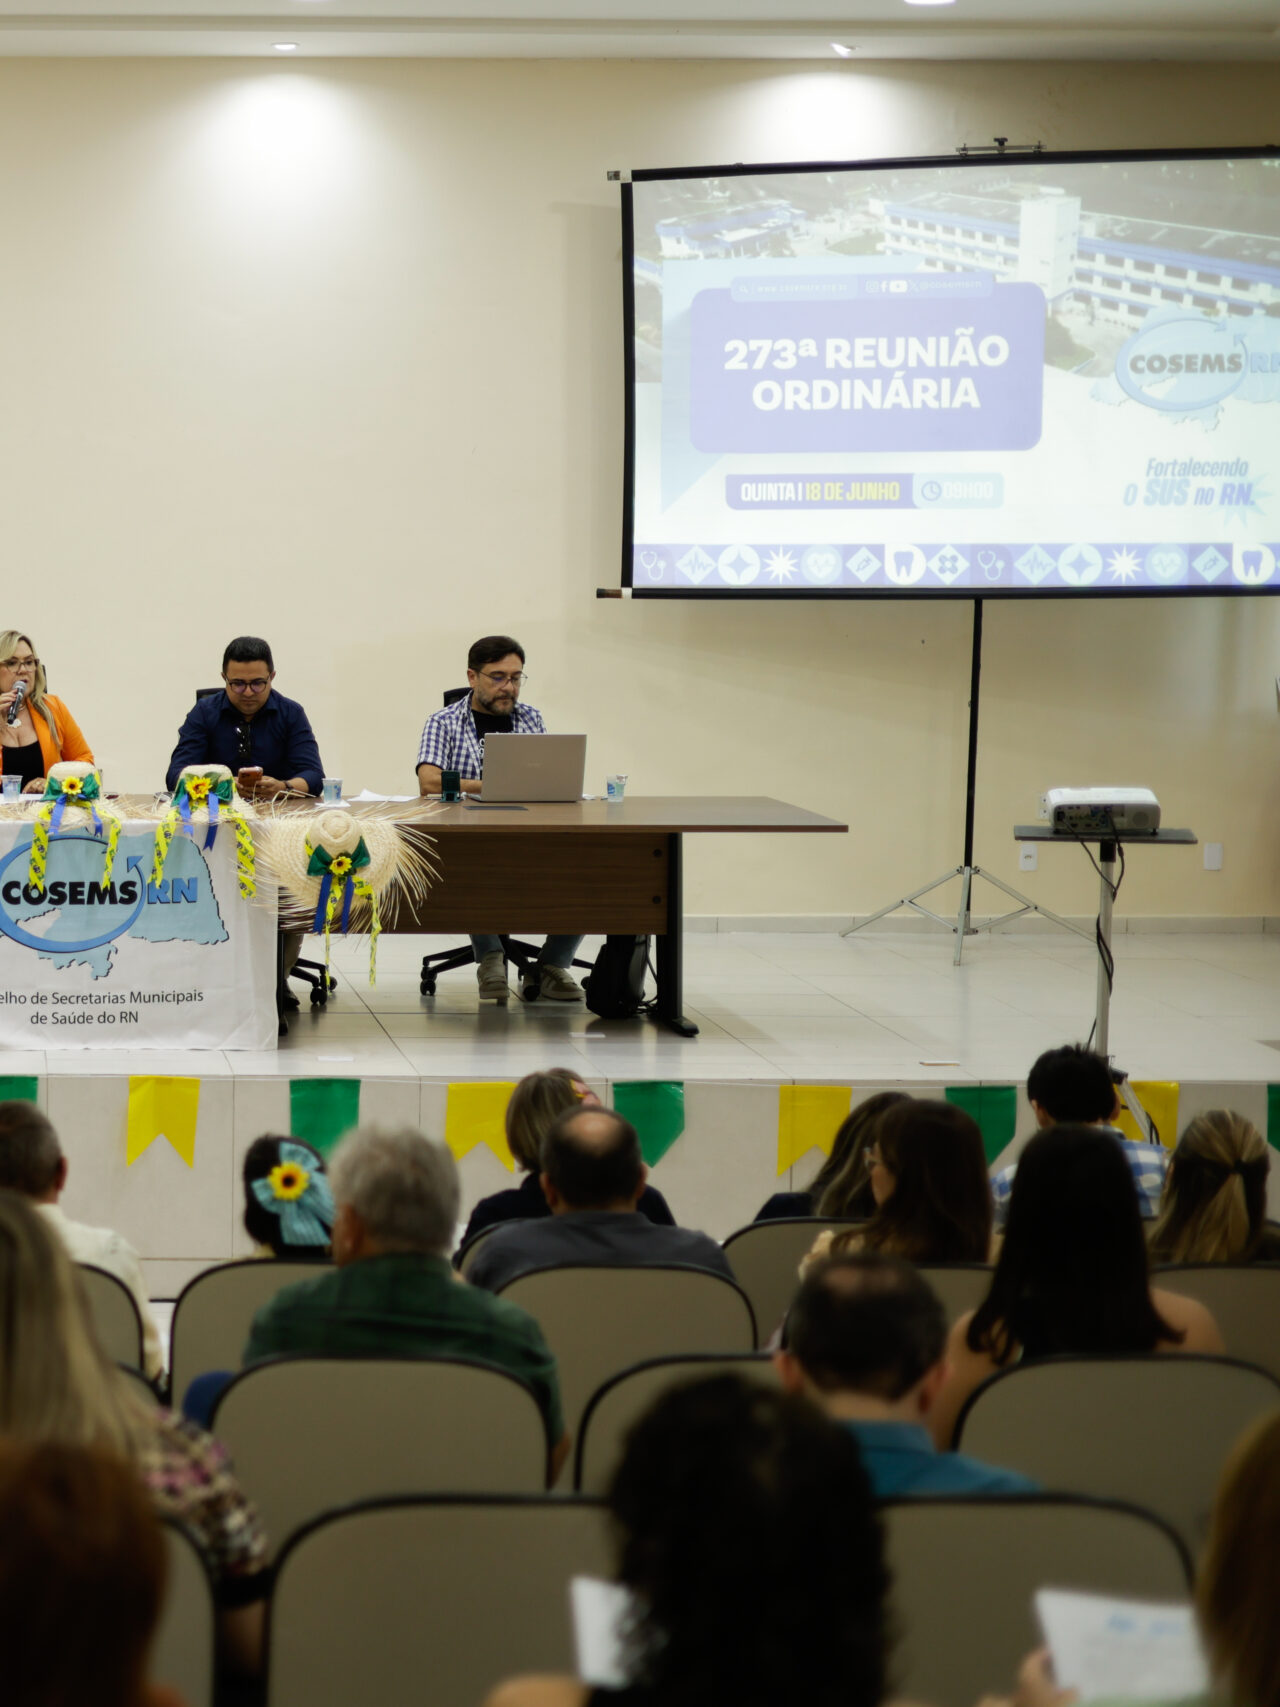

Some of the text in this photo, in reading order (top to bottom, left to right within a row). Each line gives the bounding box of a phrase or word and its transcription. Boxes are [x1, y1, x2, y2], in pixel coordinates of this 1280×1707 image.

[724, 326, 1010, 370] 273ª REUNIÃO
[1129, 353, 1243, 375] COSEMS
[752, 371, 981, 411] ORDINÁRIA
[1146, 457, 1249, 477] Fortalecendo
[740, 482, 794, 501] QUINTA
[805, 482, 821, 501] 18
[824, 482, 844, 501] DE
[845, 482, 900, 501] JUNHO
[1143, 478, 1191, 506] SUS
[1194, 486, 1215, 505] no
[1219, 482, 1255, 506] RN.
[2, 877, 198, 905] COSEMS RN
[30, 991, 48, 1005] de
[51, 991, 126, 1005] Secretarias
[129, 989, 204, 1006] Municipais
[30, 1010, 139, 1025] de Saúde do RN
